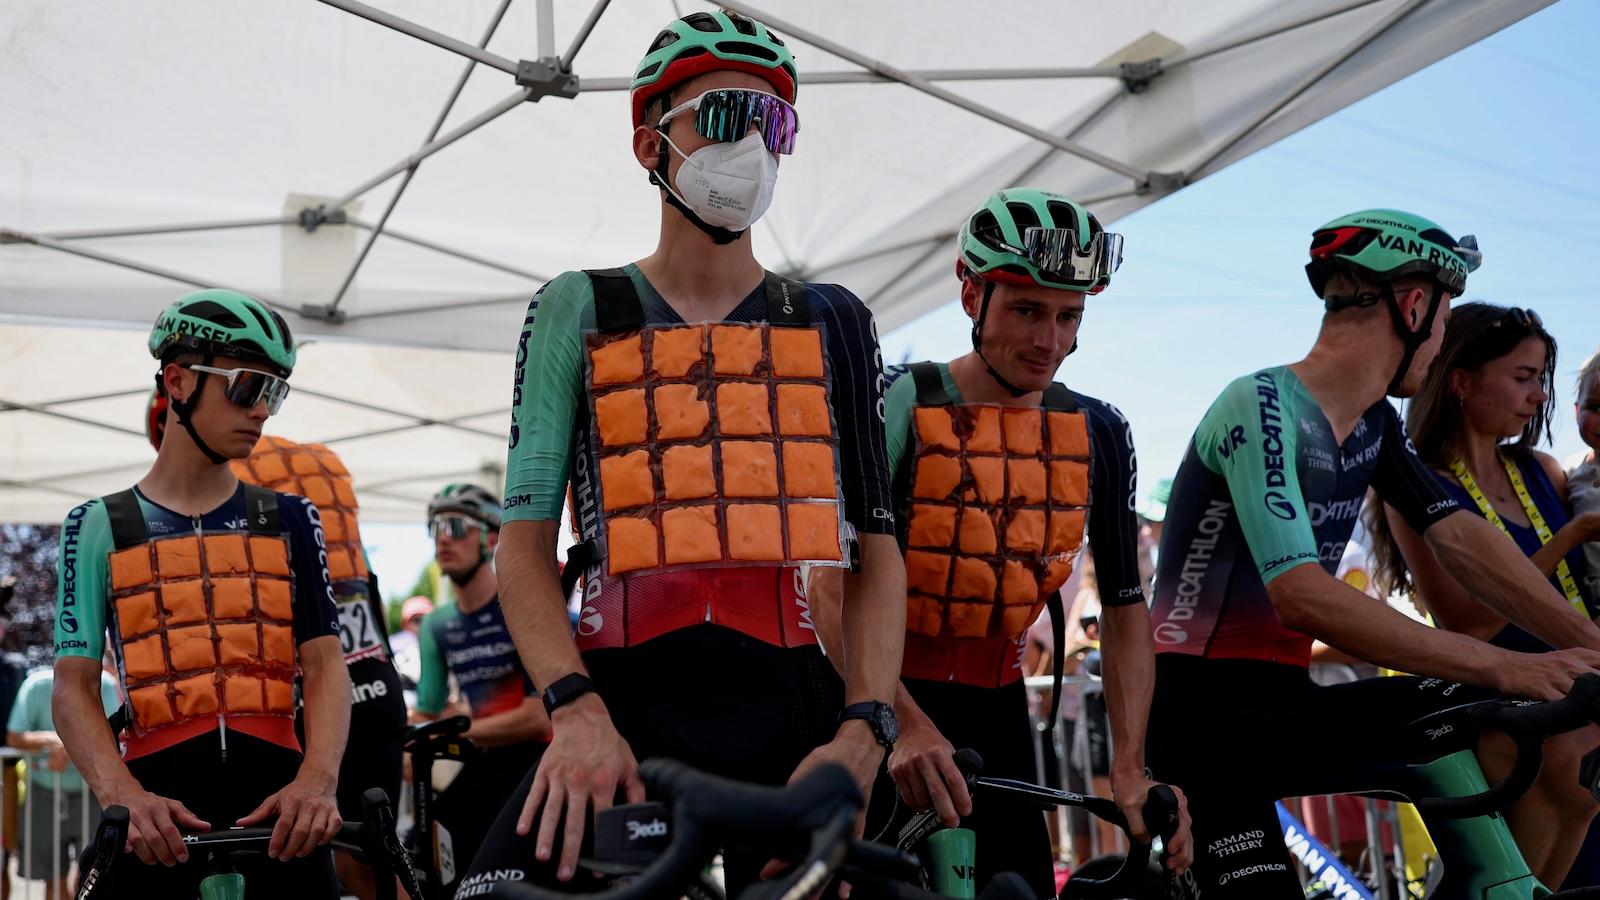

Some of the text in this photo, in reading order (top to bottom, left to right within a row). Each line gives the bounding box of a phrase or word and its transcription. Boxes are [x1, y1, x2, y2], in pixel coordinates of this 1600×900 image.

[1366, 218, 1416, 233] DECATHLON
[1377, 234, 1423, 258] VAN
[154, 316, 175, 332] AN
[1255, 371, 1286, 488] DECATHLO
[1168, 500, 1232, 621] DECATHLON
[1319, 541, 1345, 561] CG
[1207, 829, 1265, 853] ARMAND
[1215, 840, 1264, 858] THIERY
[1283, 825, 1325, 874] VAN
[1232, 863, 1287, 879] DECATHLON
